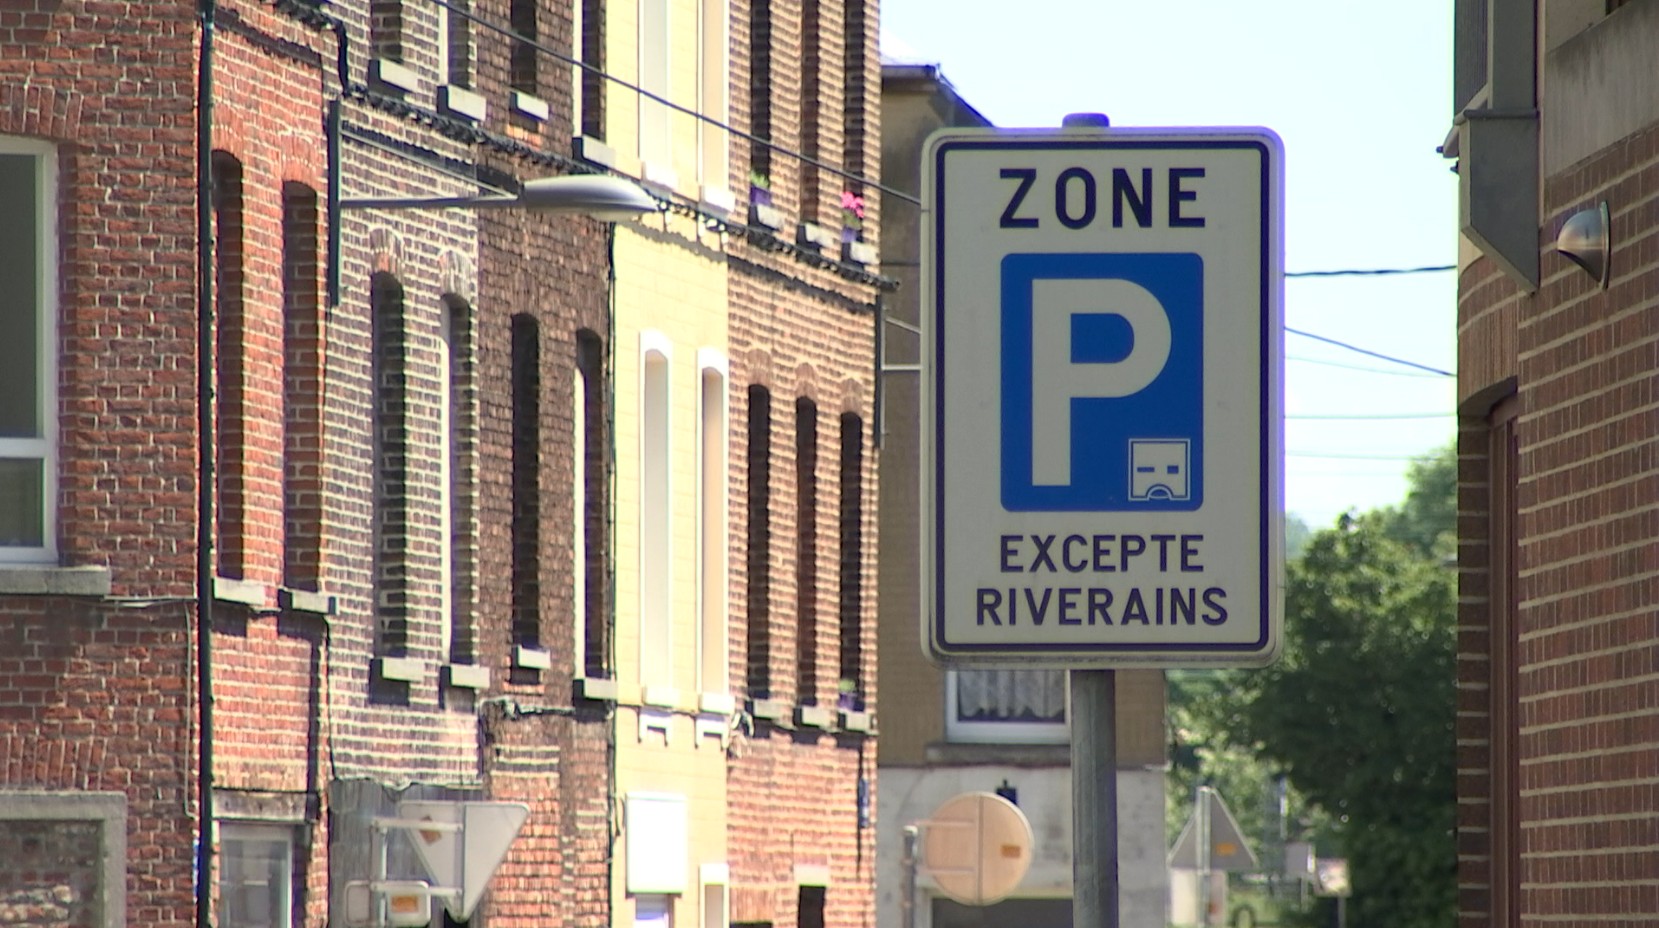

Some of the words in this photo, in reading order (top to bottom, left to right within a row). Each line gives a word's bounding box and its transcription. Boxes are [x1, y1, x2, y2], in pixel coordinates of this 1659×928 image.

[999, 166, 1206, 230] ZONE
[1032, 278, 1172, 487] P
[1000, 534, 1205, 574] EXCEPTE
[976, 586, 1229, 627] RIVERAINS
